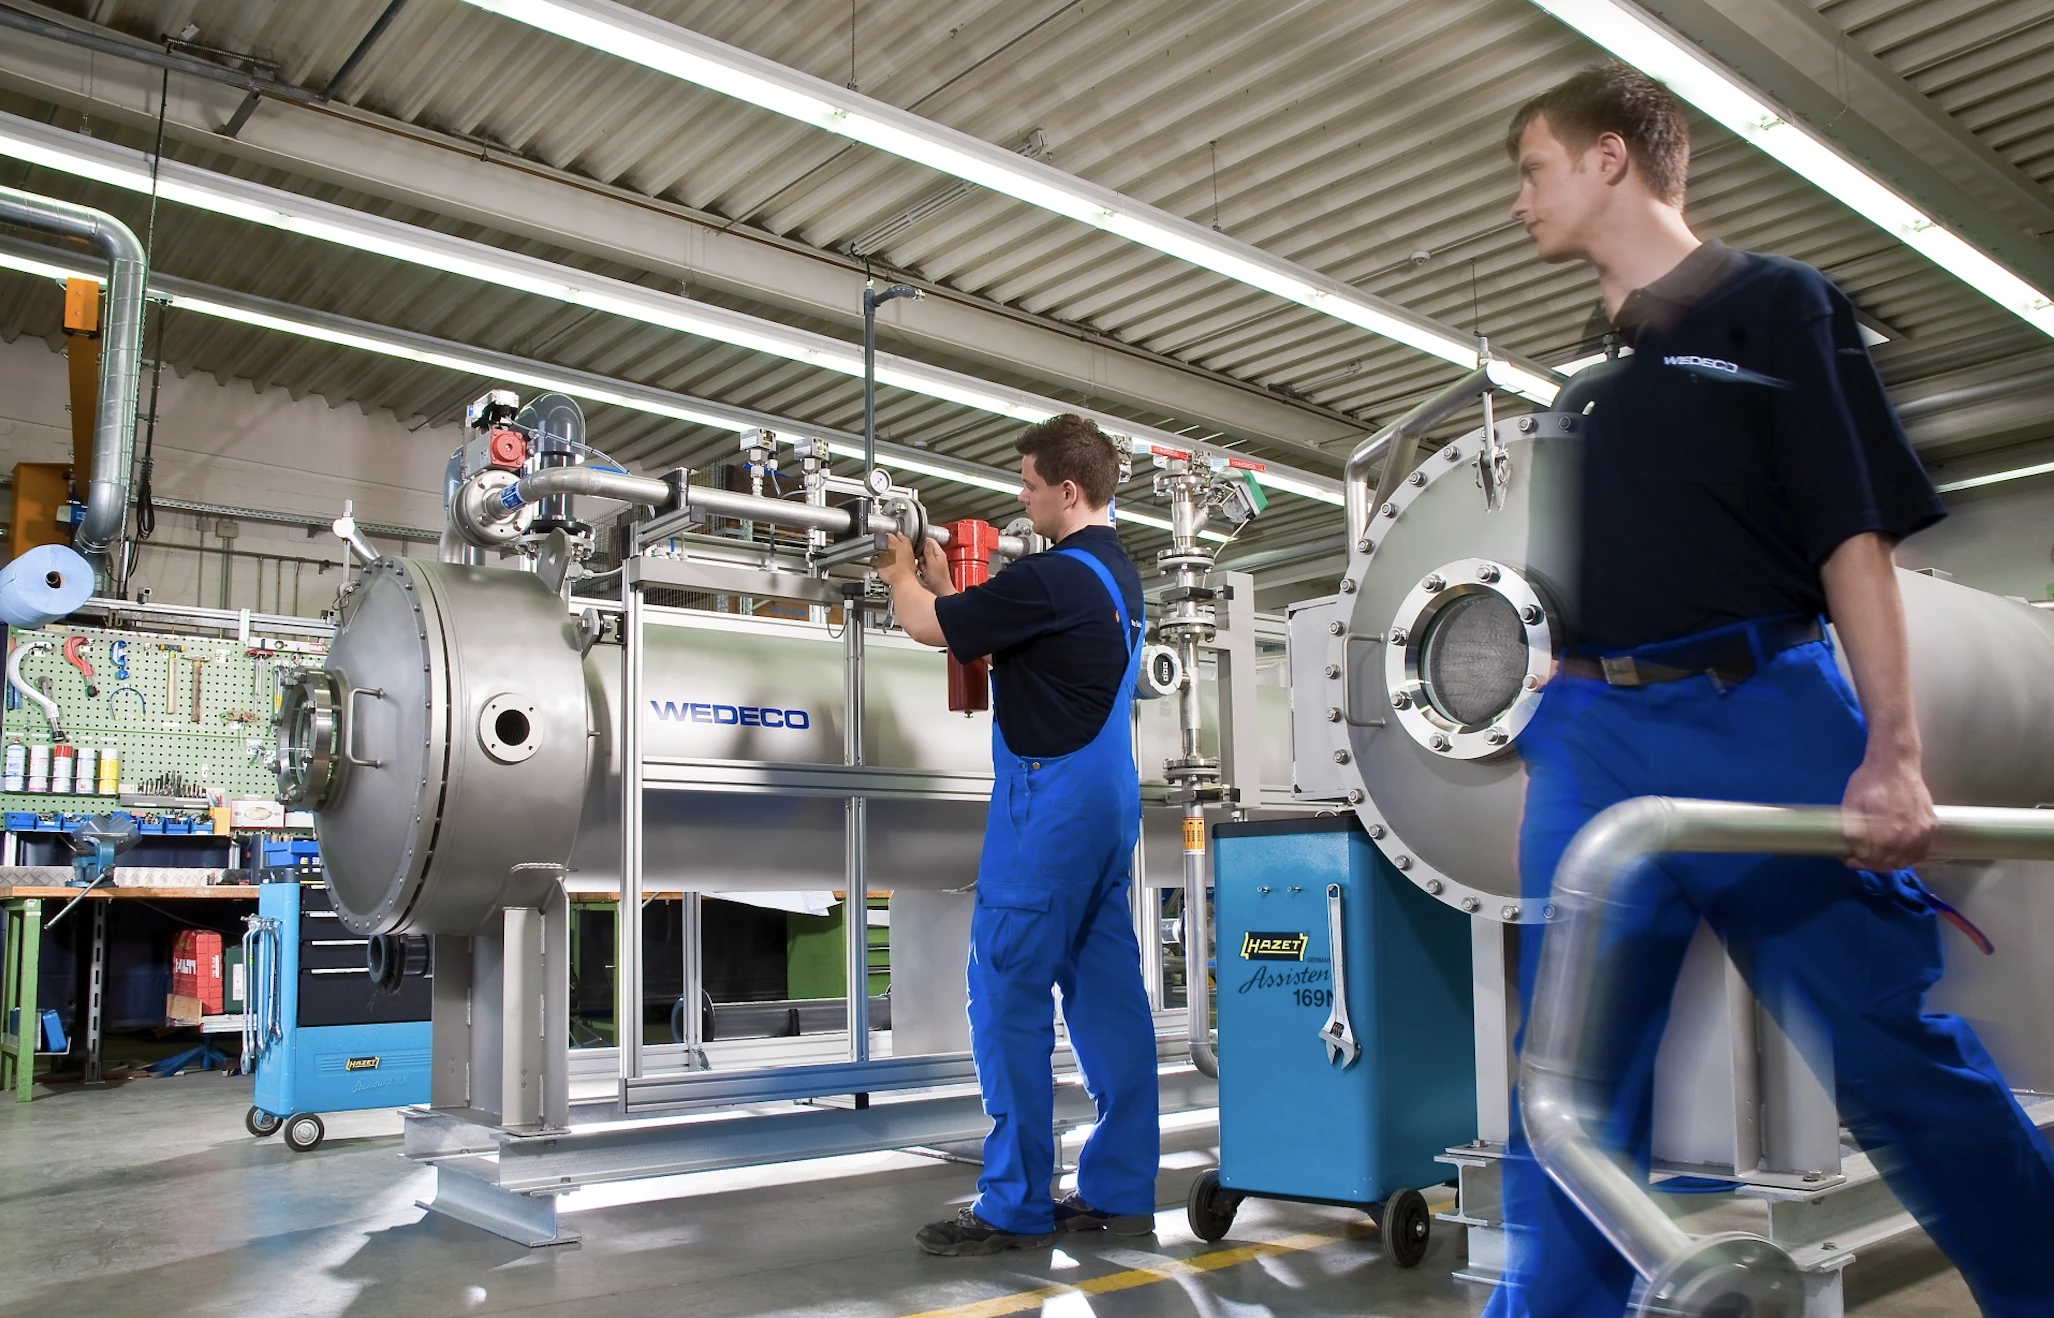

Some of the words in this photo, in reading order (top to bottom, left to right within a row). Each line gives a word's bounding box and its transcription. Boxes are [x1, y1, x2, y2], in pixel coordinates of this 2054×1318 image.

[1663, 355, 1739, 374] WEDECO
[650, 700, 810, 730] WEDECO
[1245, 937, 1302, 955] HAZET
[1306, 956, 1331, 964] GERMAN
[1238, 965, 1330, 995] Assisten
[348, 1058, 377, 1069] HAZET
